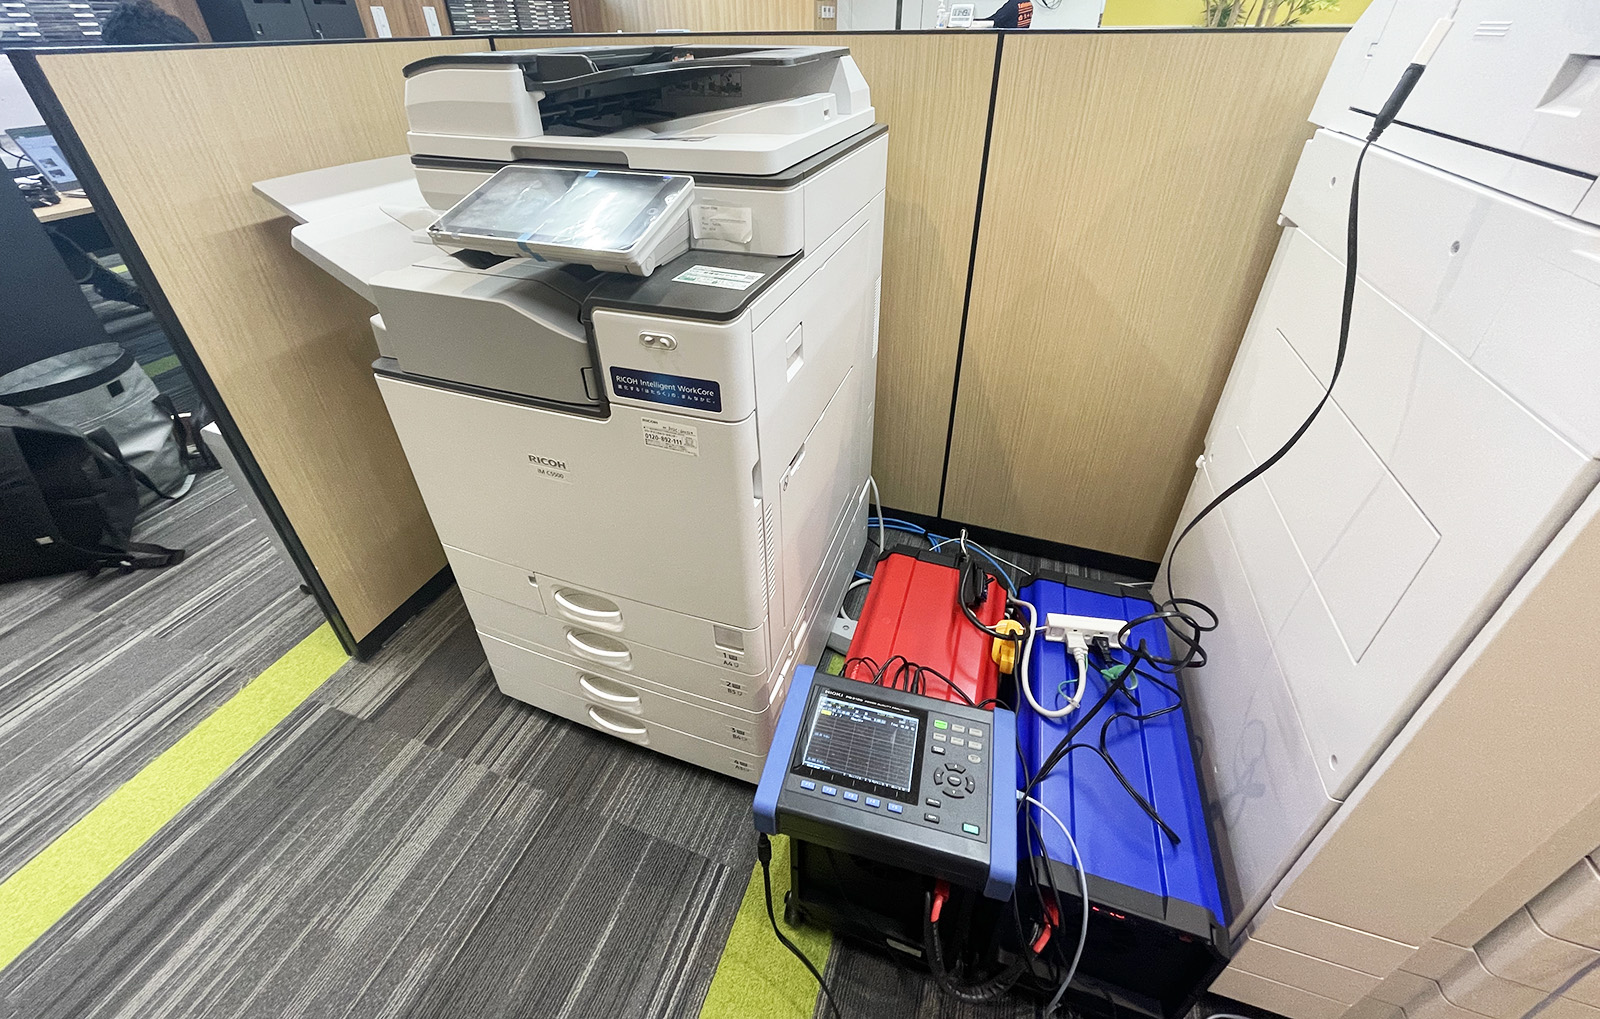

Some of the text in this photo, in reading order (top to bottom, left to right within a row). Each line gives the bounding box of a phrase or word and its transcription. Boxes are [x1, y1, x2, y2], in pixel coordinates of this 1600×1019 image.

[615, 375, 714, 397] RICOH Intelligent WorkCore
[528, 454, 566, 470] RICOH
